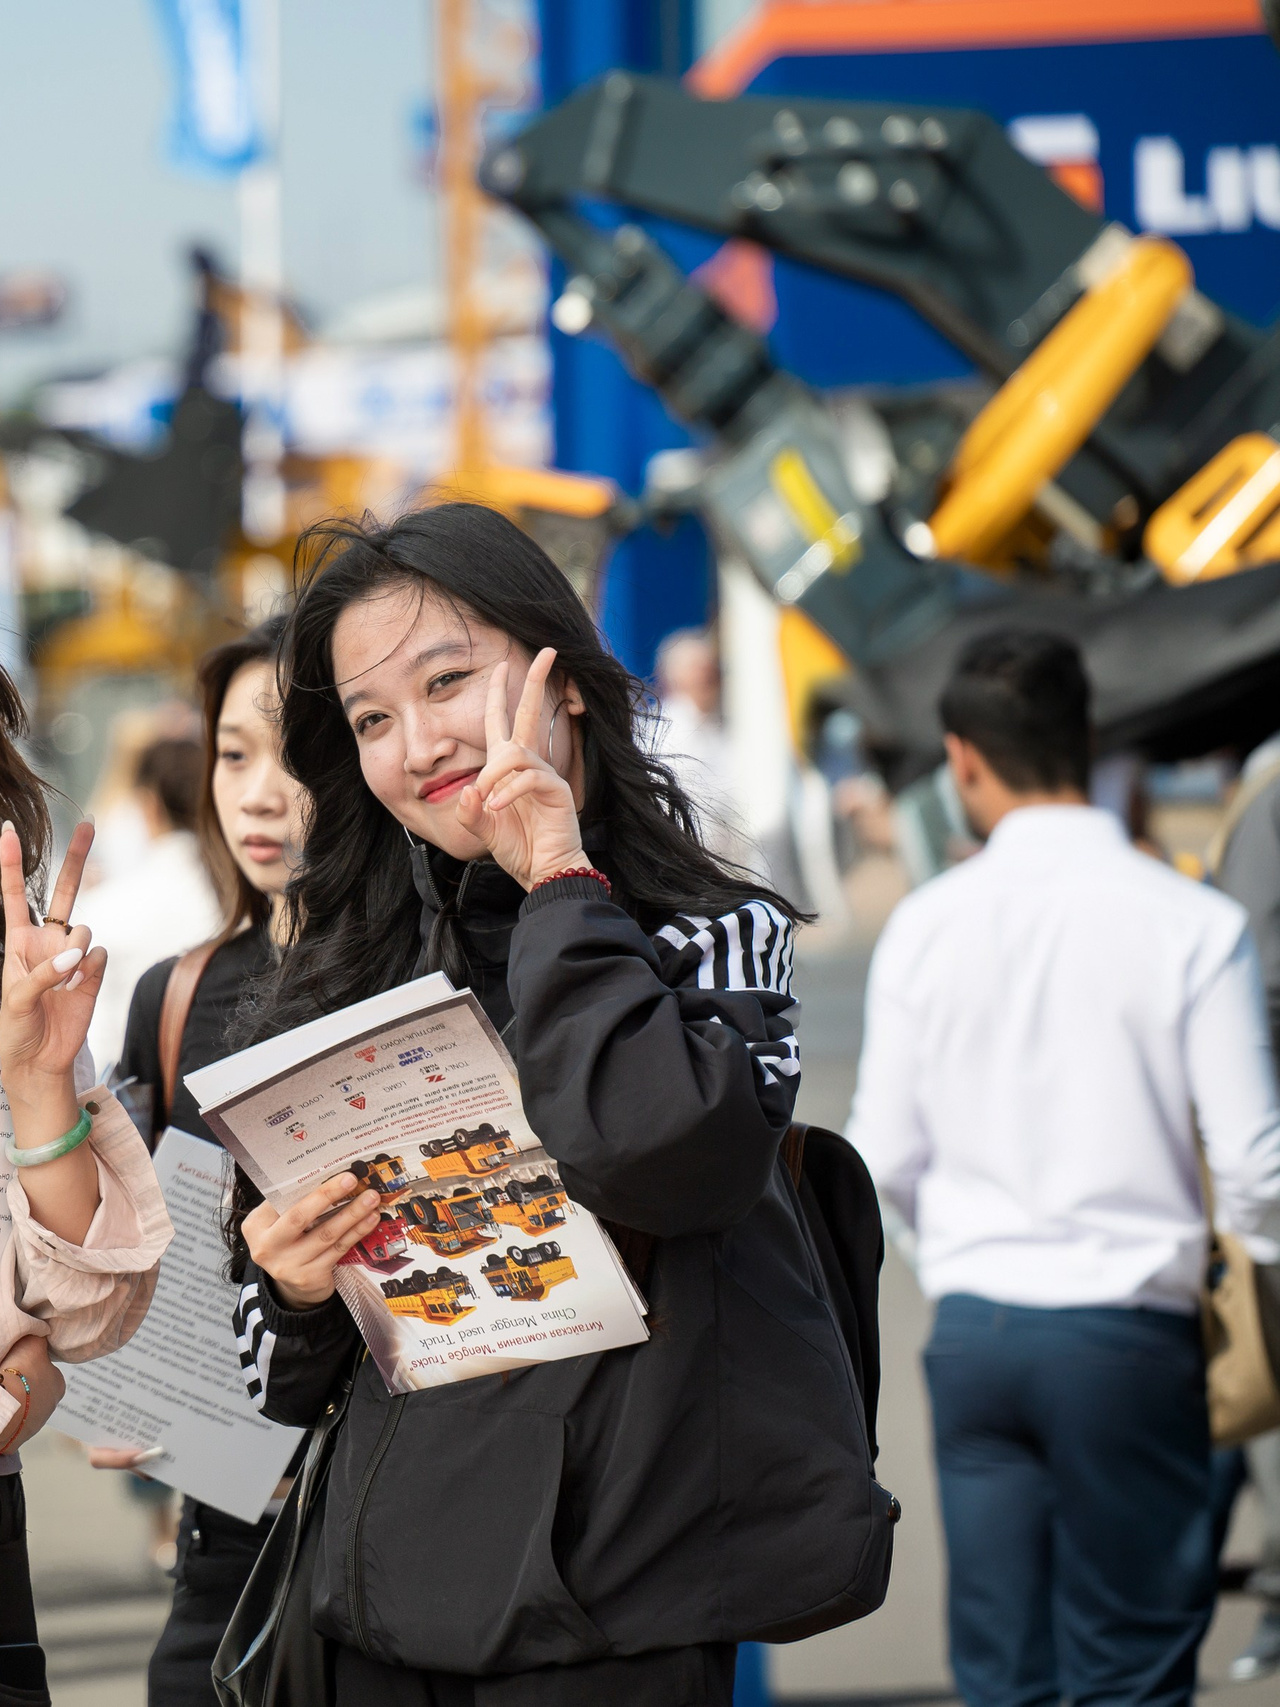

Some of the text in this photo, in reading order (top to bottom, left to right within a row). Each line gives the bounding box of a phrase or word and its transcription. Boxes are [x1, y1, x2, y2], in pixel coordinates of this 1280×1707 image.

[434, 1042, 457, 1053] XCMG
[444, 1060, 470, 1072] TONLY
[357, 1063, 395, 1082] SHACMAN
[383, 1081, 407, 1093] LGMG
[442, 1084, 460, 1092] spare
[461, 1079, 473, 1088] and
[458, 1084, 487, 1096] company
[298, 1094, 325, 1110] LOVOL
[403, 1096, 420, 1105] Main
[424, 1095, 444, 1107] global
[318, 1109, 337, 1121] Sany
[373, 1114, 389, 1124] used
[350, 1121, 372, 1133] mining
[305, 1141, 327, 1155] mining
[286, 1153, 305, 1165] dump
[190, 1197, 216, 1214] Meng
[419, 1308, 576, 1350] China Mengge used Truck
[409, 1321, 604, 1371] Китайская компания "MengGe Trucks"
